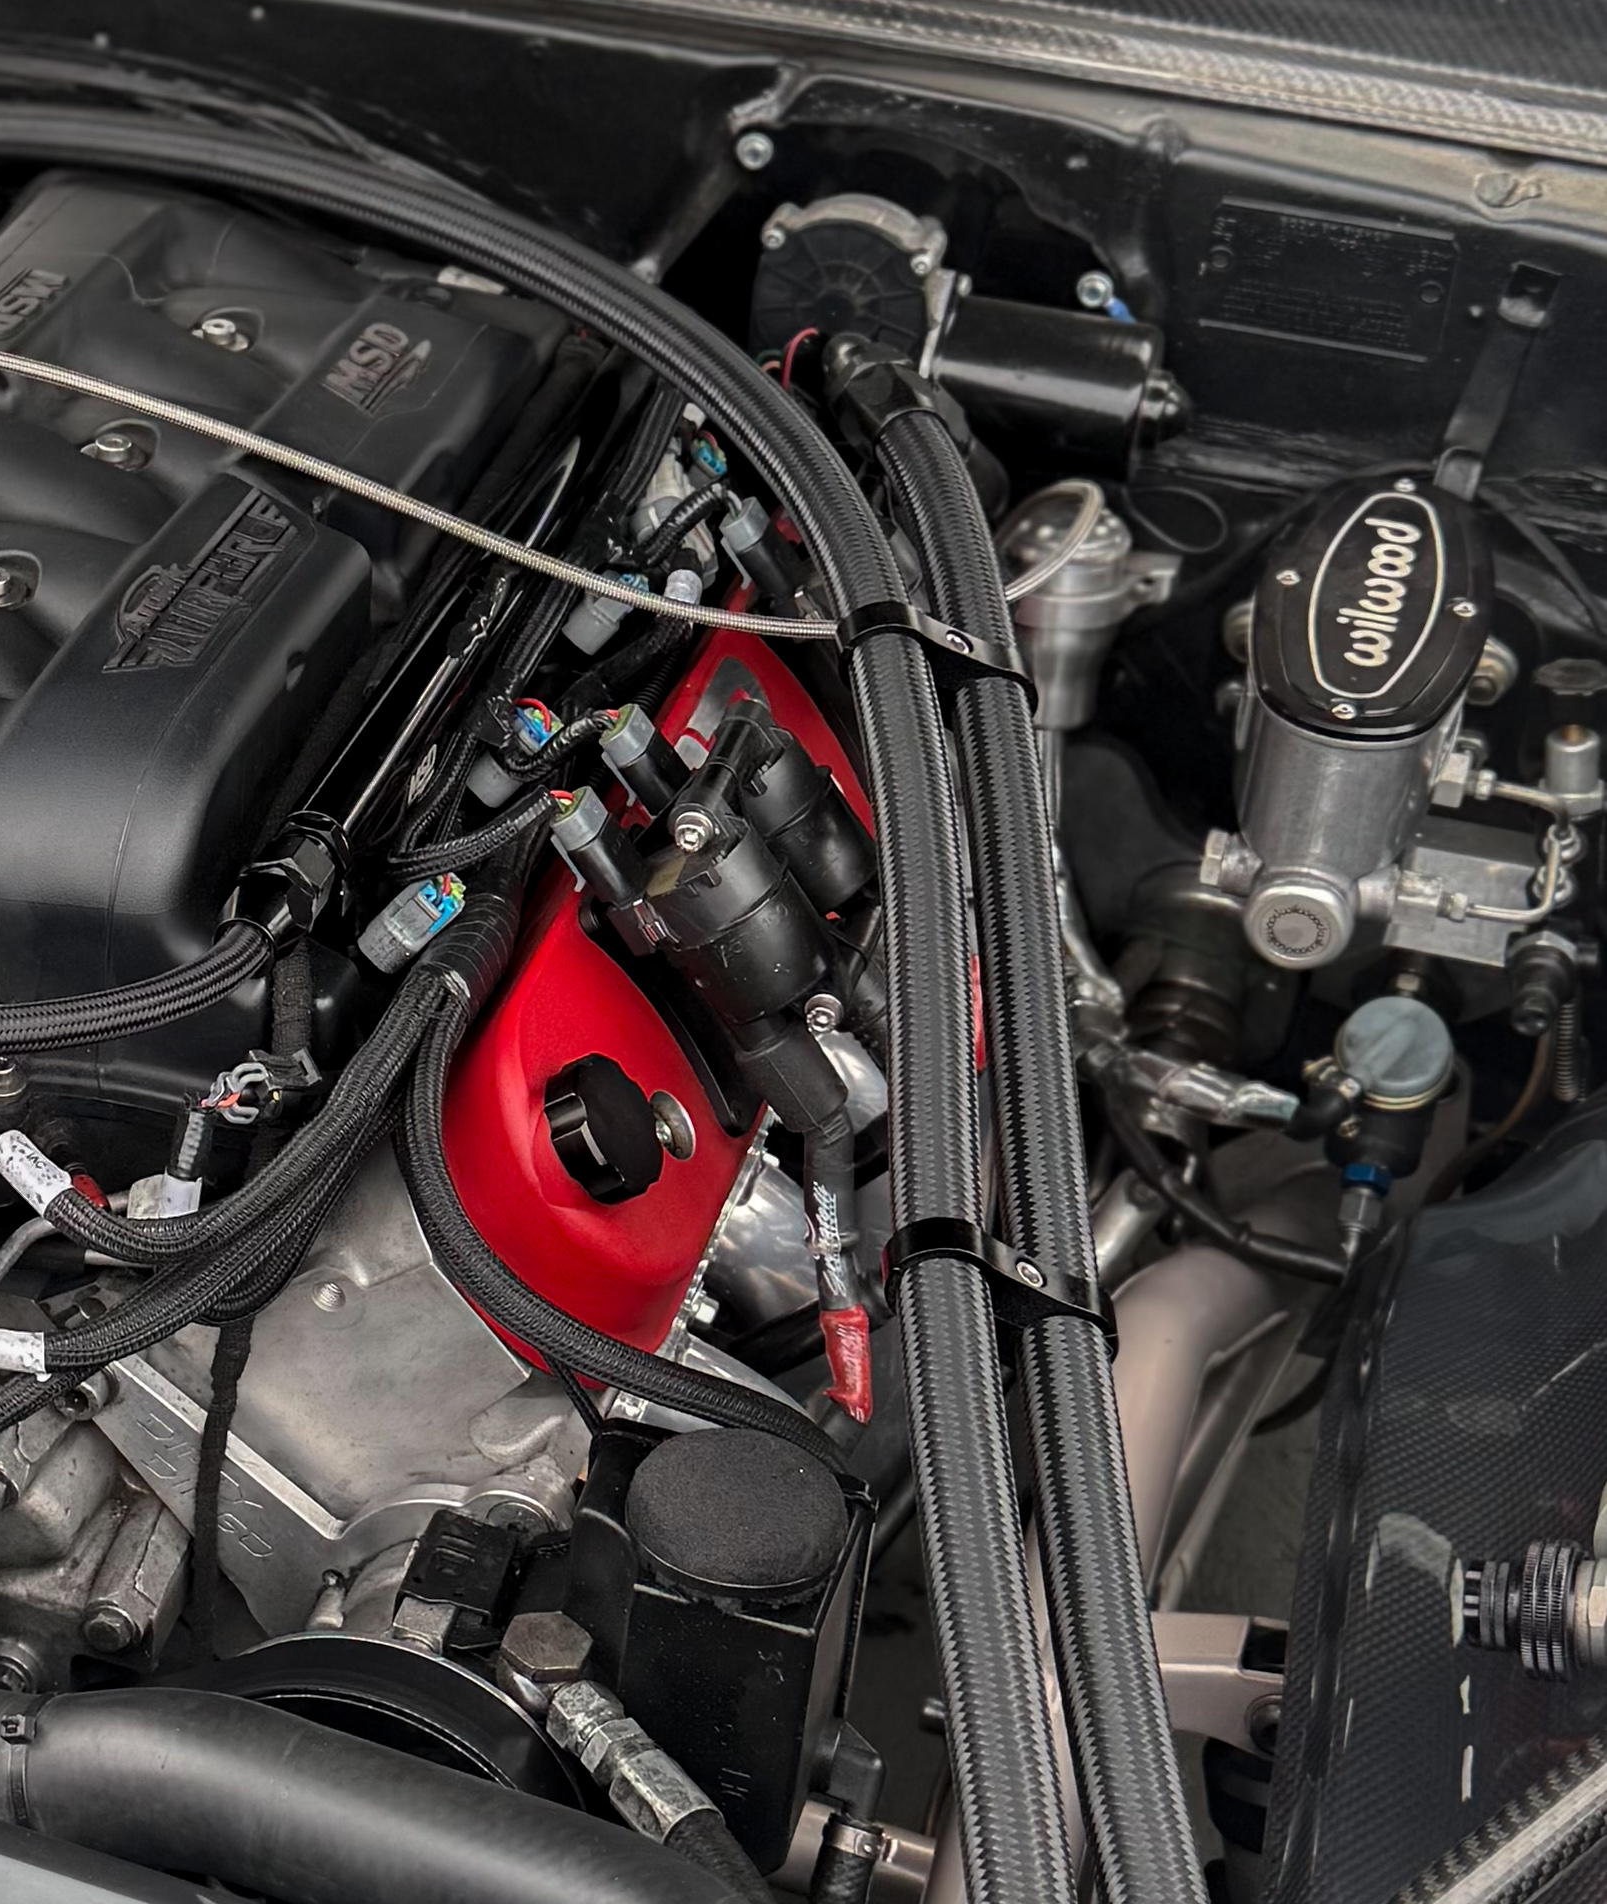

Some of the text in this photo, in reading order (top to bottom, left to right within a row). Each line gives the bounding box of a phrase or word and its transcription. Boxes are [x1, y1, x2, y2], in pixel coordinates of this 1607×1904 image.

[323, 322, 410, 405] MSD
[1336, 518, 1422, 667] wilwood
[135, 1412, 264, 1509] DIRY
[140, 1452, 275, 1558] DIGO
